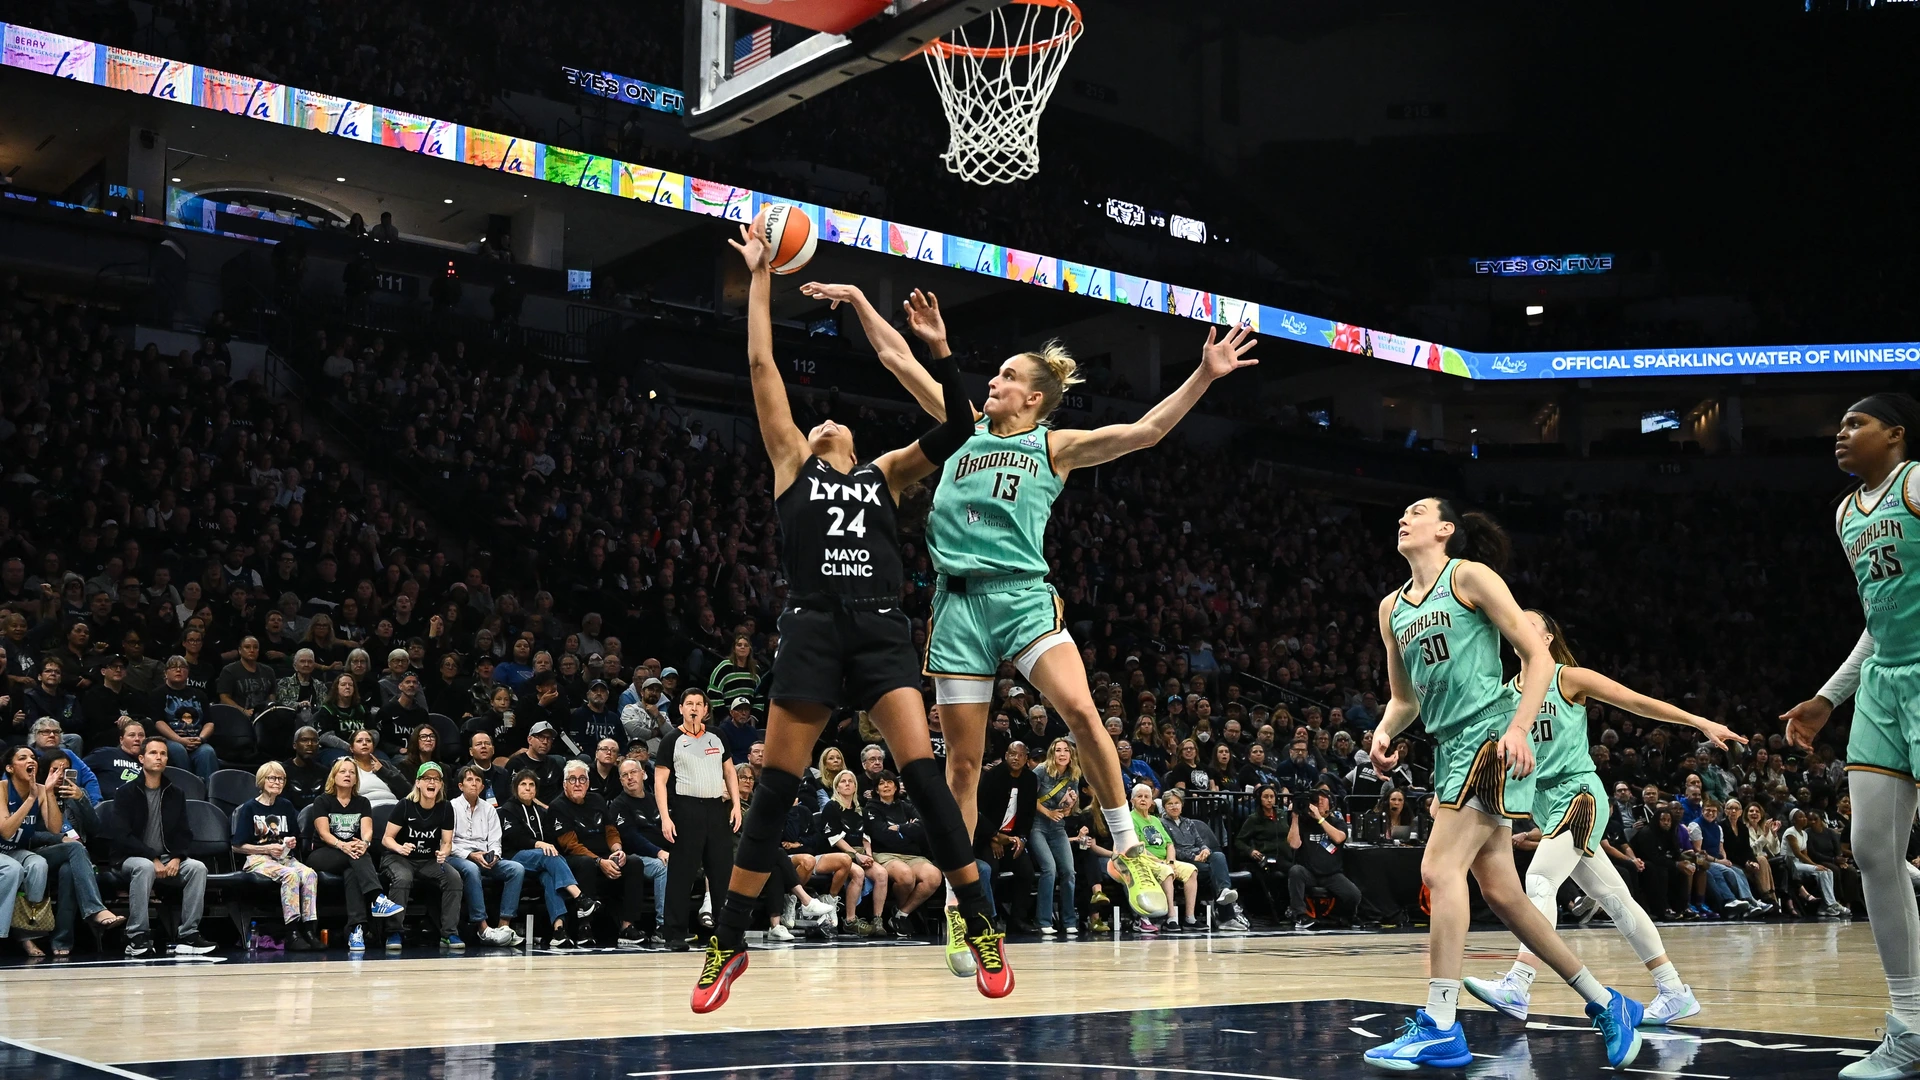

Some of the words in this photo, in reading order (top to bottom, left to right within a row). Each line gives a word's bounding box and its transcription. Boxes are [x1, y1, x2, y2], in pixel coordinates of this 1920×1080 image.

[15, 36, 46, 49] BERRY
[562, 66, 619, 95] EYES
[625, 83, 656, 104] ON
[765, 205, 786, 244] Wilson
[1476, 260, 1527, 273] EYES
[1534, 259, 1562, 272] ON
[1567, 257, 1611, 270] FIVE
[1378, 335, 1406, 346] NATURALLY
[1379, 343, 1406, 354] ESSENCED
[793, 358, 816, 374] 112
[1552, 355, 1631, 371] OFFICIAL
[1633, 352, 1734, 369] SPARKLING
[1736, 351, 1801, 366] WATER
[1805, 350, 1830, 365] OF
[1834, 347, 1920, 364] MINNESO
[1064, 395, 1083, 408] 113
[954, 451, 1039, 483] BROOKLYN
[807, 476, 882, 507] LYNX
[991, 472, 1021, 503] 13
[826, 506, 867, 539] 24
[824, 548, 870, 562] MAYO
[1869, 543, 1905, 582] 35
[821, 562, 874, 578] CLINIC
[1419, 632, 1451, 667] 30
[186, 678, 208, 689] LYNX
[340, 720, 365, 731] LYNX
[409, 826, 439, 839] LYNX
